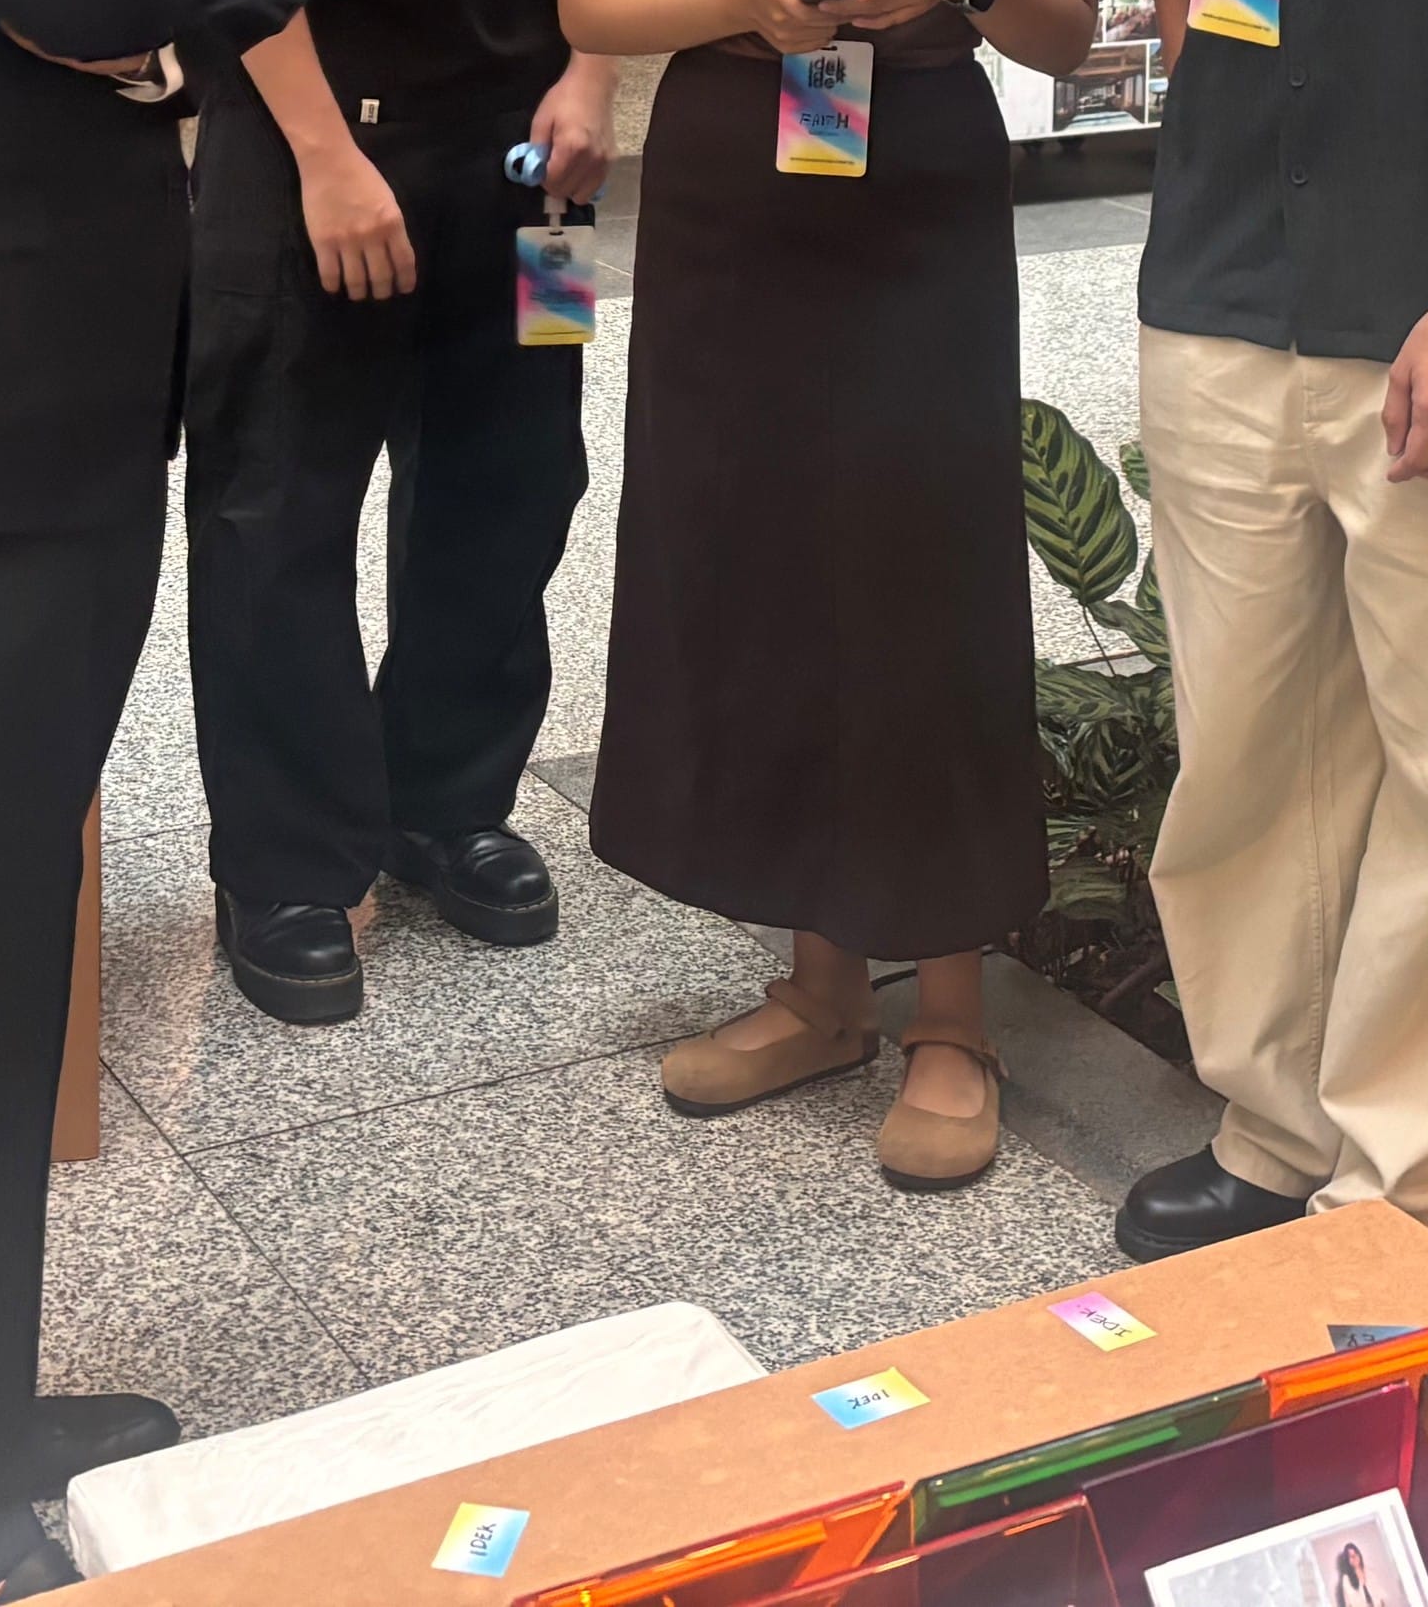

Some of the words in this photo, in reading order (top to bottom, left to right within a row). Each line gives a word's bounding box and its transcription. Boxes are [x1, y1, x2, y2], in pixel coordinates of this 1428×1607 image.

[800, 112, 849, 129] FAITH
[847, 1389, 891, 1410] IDEK
[469, 1523, 497, 1557] IDEK
